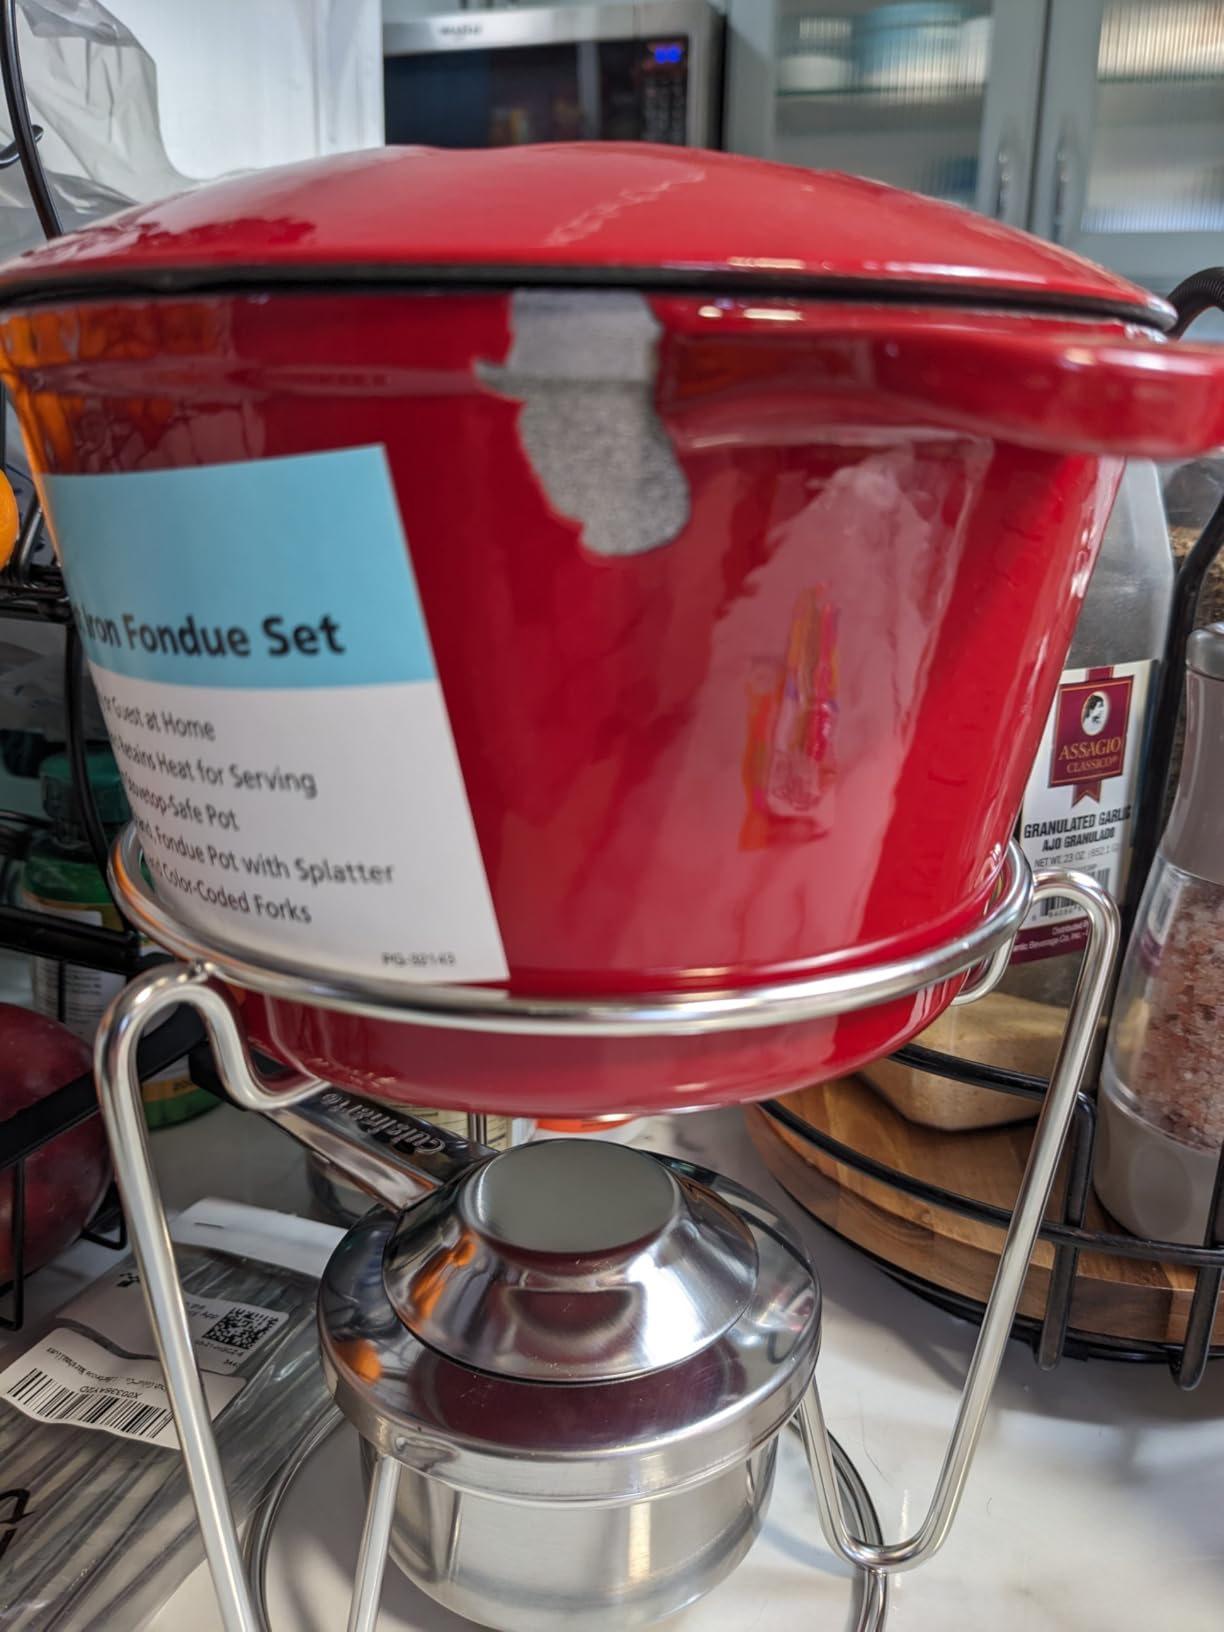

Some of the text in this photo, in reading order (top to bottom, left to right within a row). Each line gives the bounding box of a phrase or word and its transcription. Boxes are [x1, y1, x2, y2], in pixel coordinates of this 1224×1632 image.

[122, 612, 251, 658] Fondue
[261, 613, 347, 659] Set
[162, 709, 217, 741] Home
[1058, 736, 1121, 760] ASSAGIO
[156, 750, 196, 782] Heat
[197, 758, 225, 787] for
[228, 763, 319, 799] Serving
[205, 803, 240, 832] Pot
[1023, 805, 1132, 839] GRANULATED GARLIC
[1042, 836, 1062, 852] AJO
[1064, 827, 1116, 850] GRANULADO
[156, 827, 205, 865] Fondue
[206, 844, 239, 873] Pot
[241, 851, 291, 880] with
[294, 857, 395, 887] Splatter
[253, 894, 313, 925] Forks
